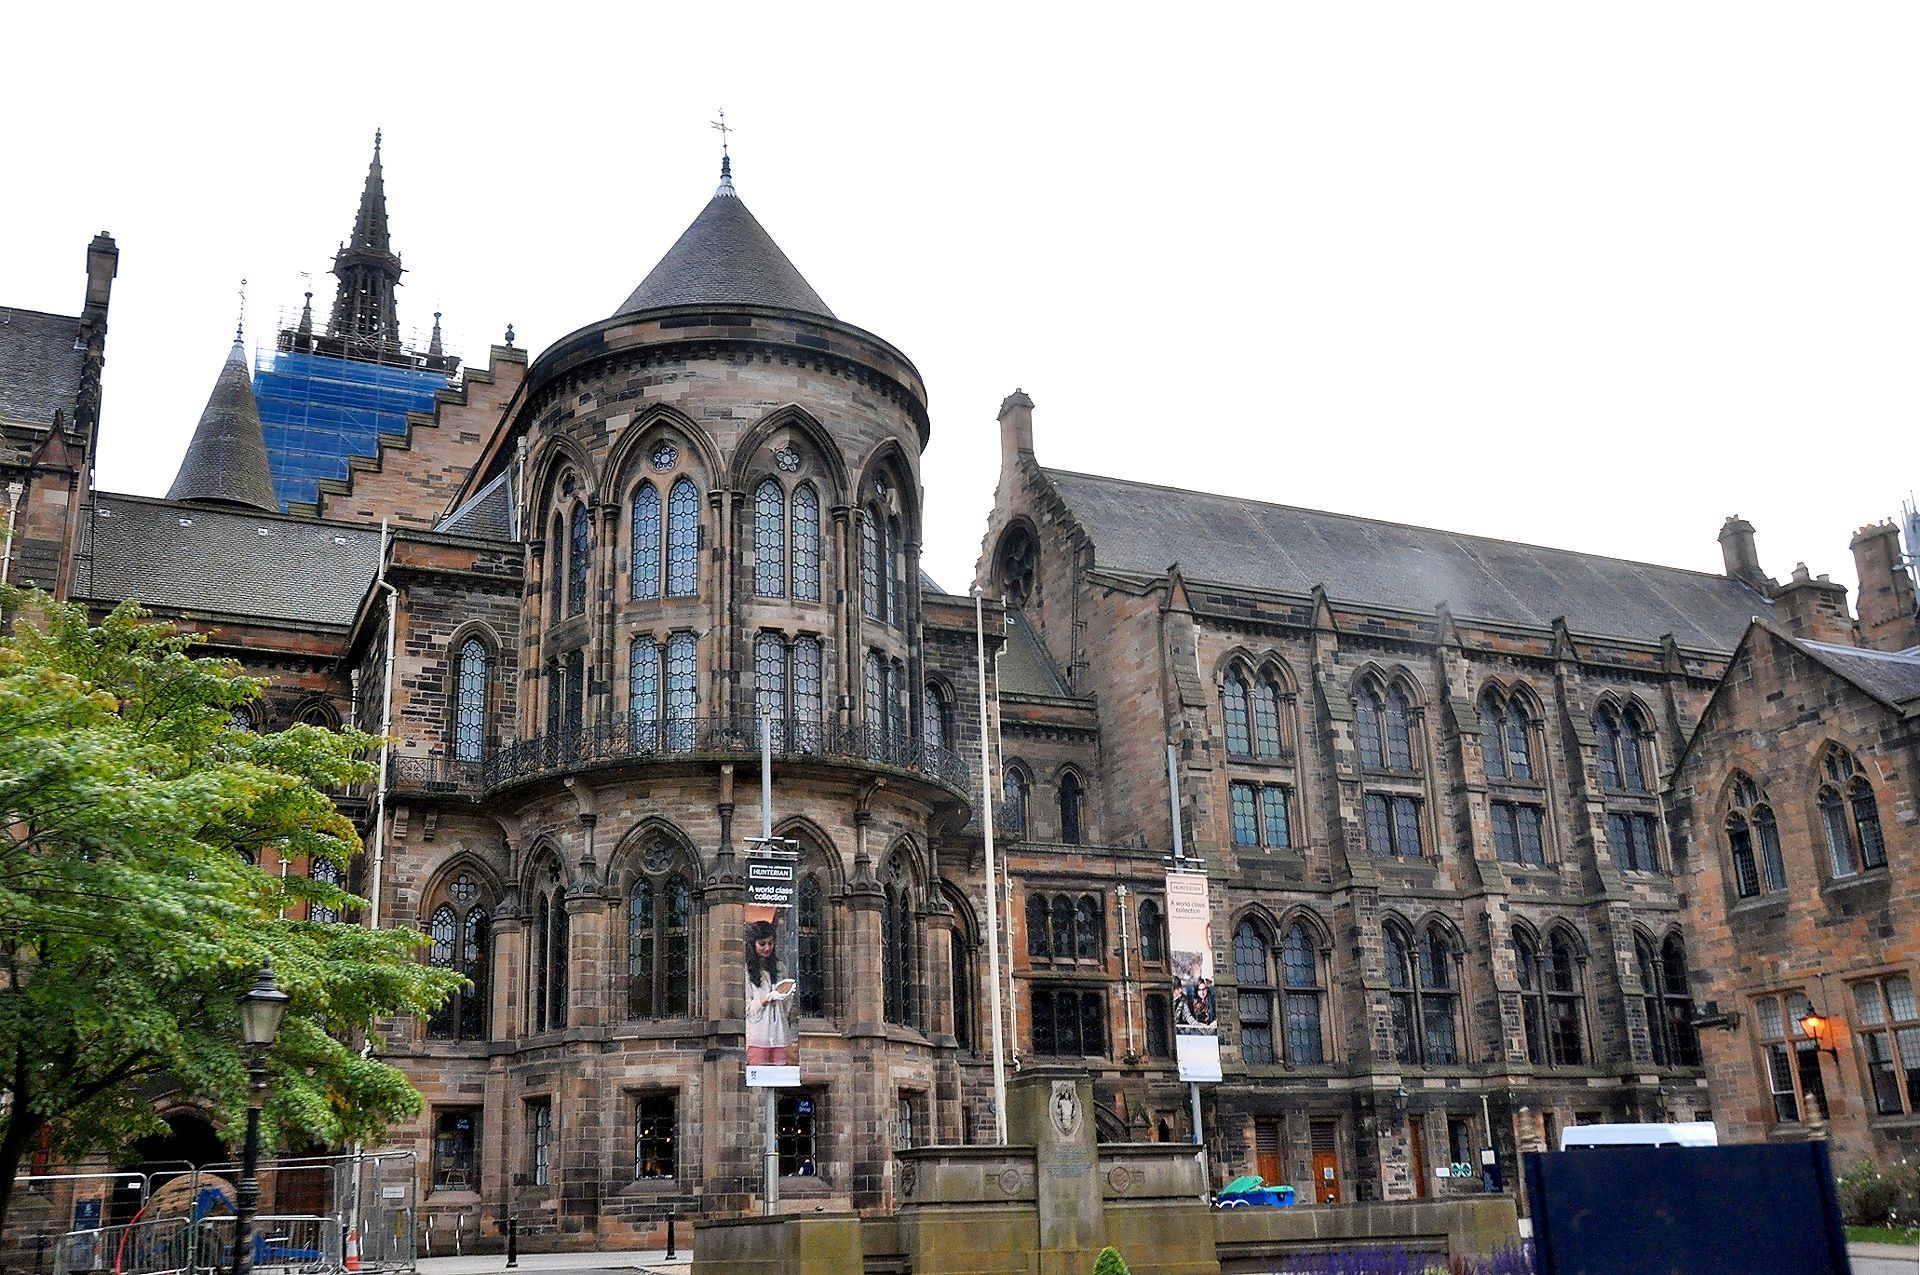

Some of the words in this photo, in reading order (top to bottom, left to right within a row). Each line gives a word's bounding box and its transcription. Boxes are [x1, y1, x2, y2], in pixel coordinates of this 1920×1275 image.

[753, 869, 789, 877] HUNTERIAN
[748, 885, 755, 893] A
[755, 886, 774, 894] world
[775, 887, 793, 895] class
